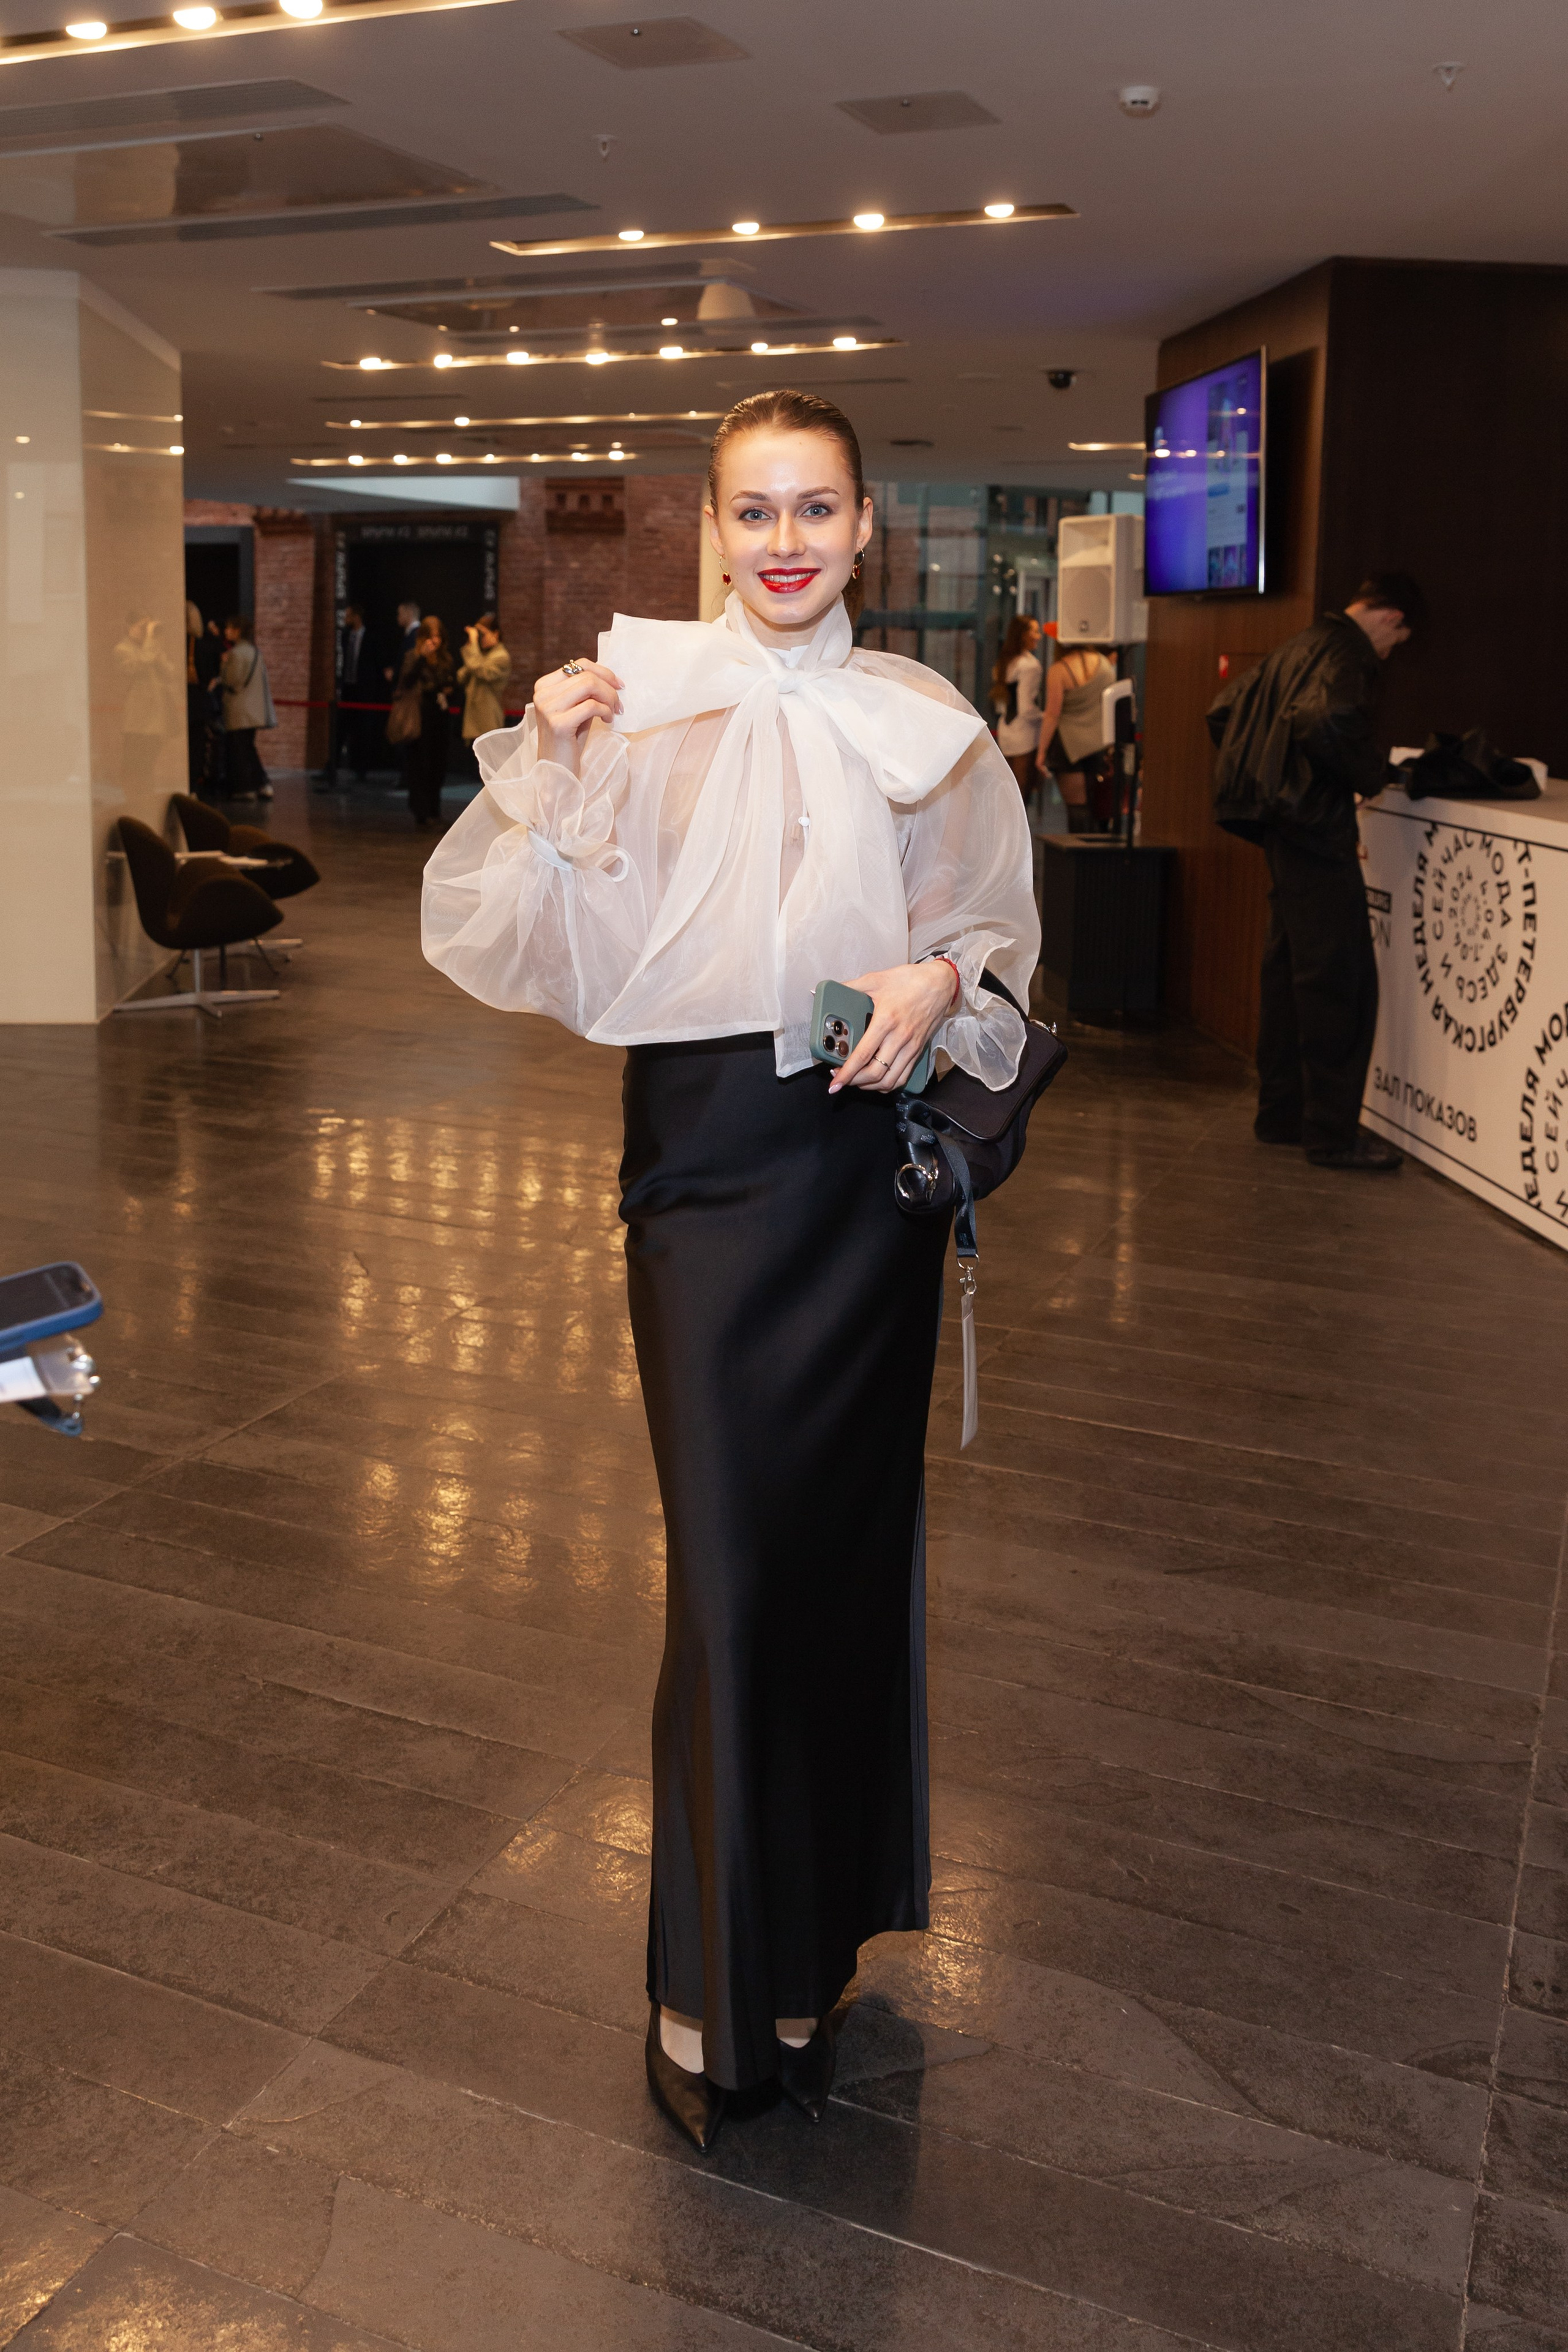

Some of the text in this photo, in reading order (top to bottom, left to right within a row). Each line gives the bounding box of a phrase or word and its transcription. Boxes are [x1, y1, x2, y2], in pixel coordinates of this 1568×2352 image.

[1412, 851, 1434, 995] НЕДЕЛЯ
[1431, 830, 1474, 940] СЕЙЧАС
[1479, 834, 1512, 929] МОДА
[1431, 841, 1537, 1053] Т-ПЕТЕРБУРГСКАЯ
[1456, 943, 1508, 1003] ЗДЕСЬ
[1534, 1000, 1568, 1066] МО
[1374, 1066, 1477, 1142] ЗАЛ ПОКАЗОВ
